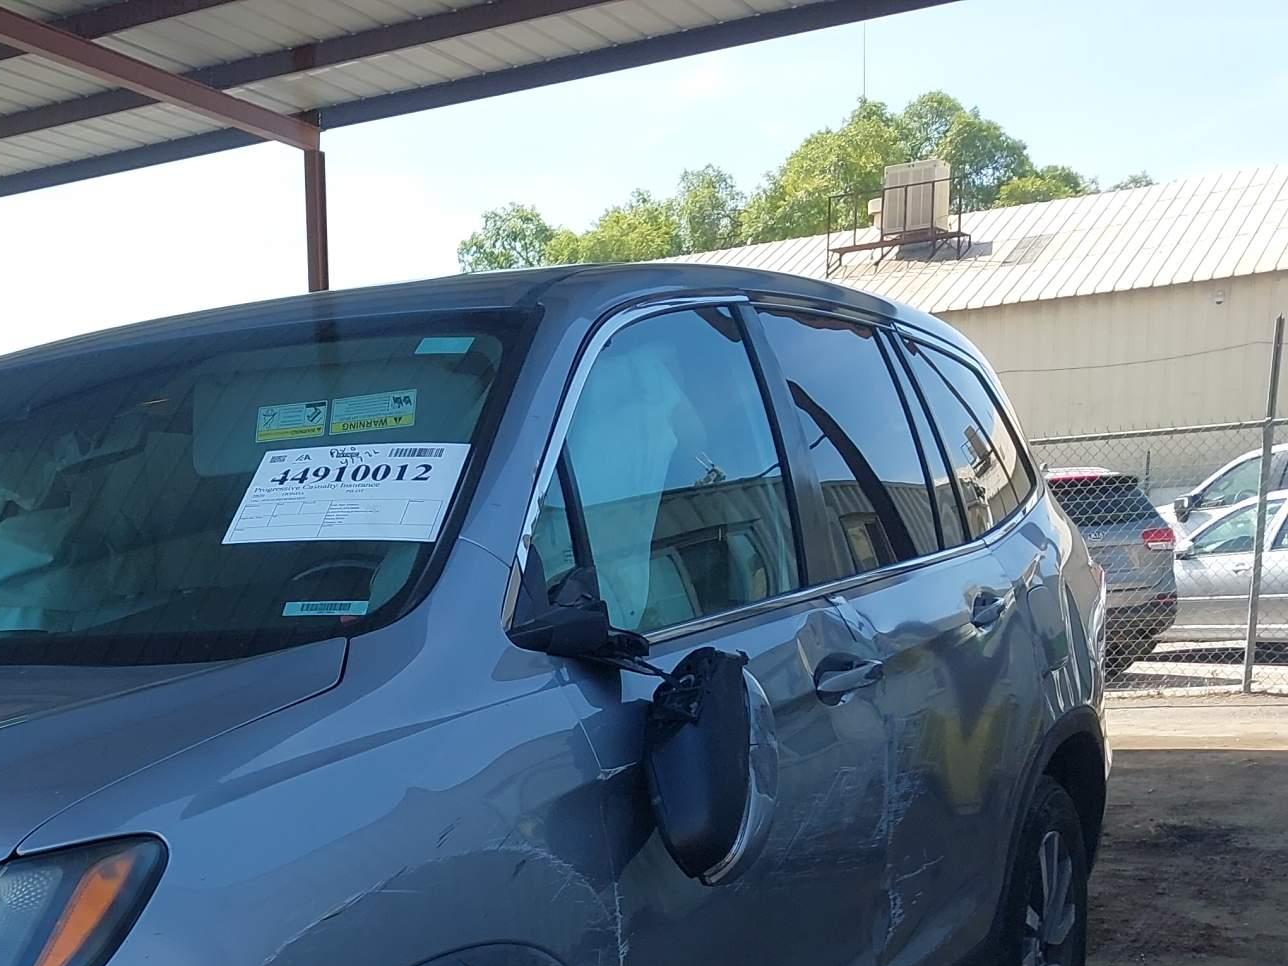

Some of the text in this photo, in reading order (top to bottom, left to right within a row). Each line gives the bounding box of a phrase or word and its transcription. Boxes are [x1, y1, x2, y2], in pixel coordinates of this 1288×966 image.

[341, 416, 389, 432] WARNING
[270, 463, 433, 486] 44910012
[253, 484, 301, 493] Progressive
[302, 482, 338, 490] Casualty
